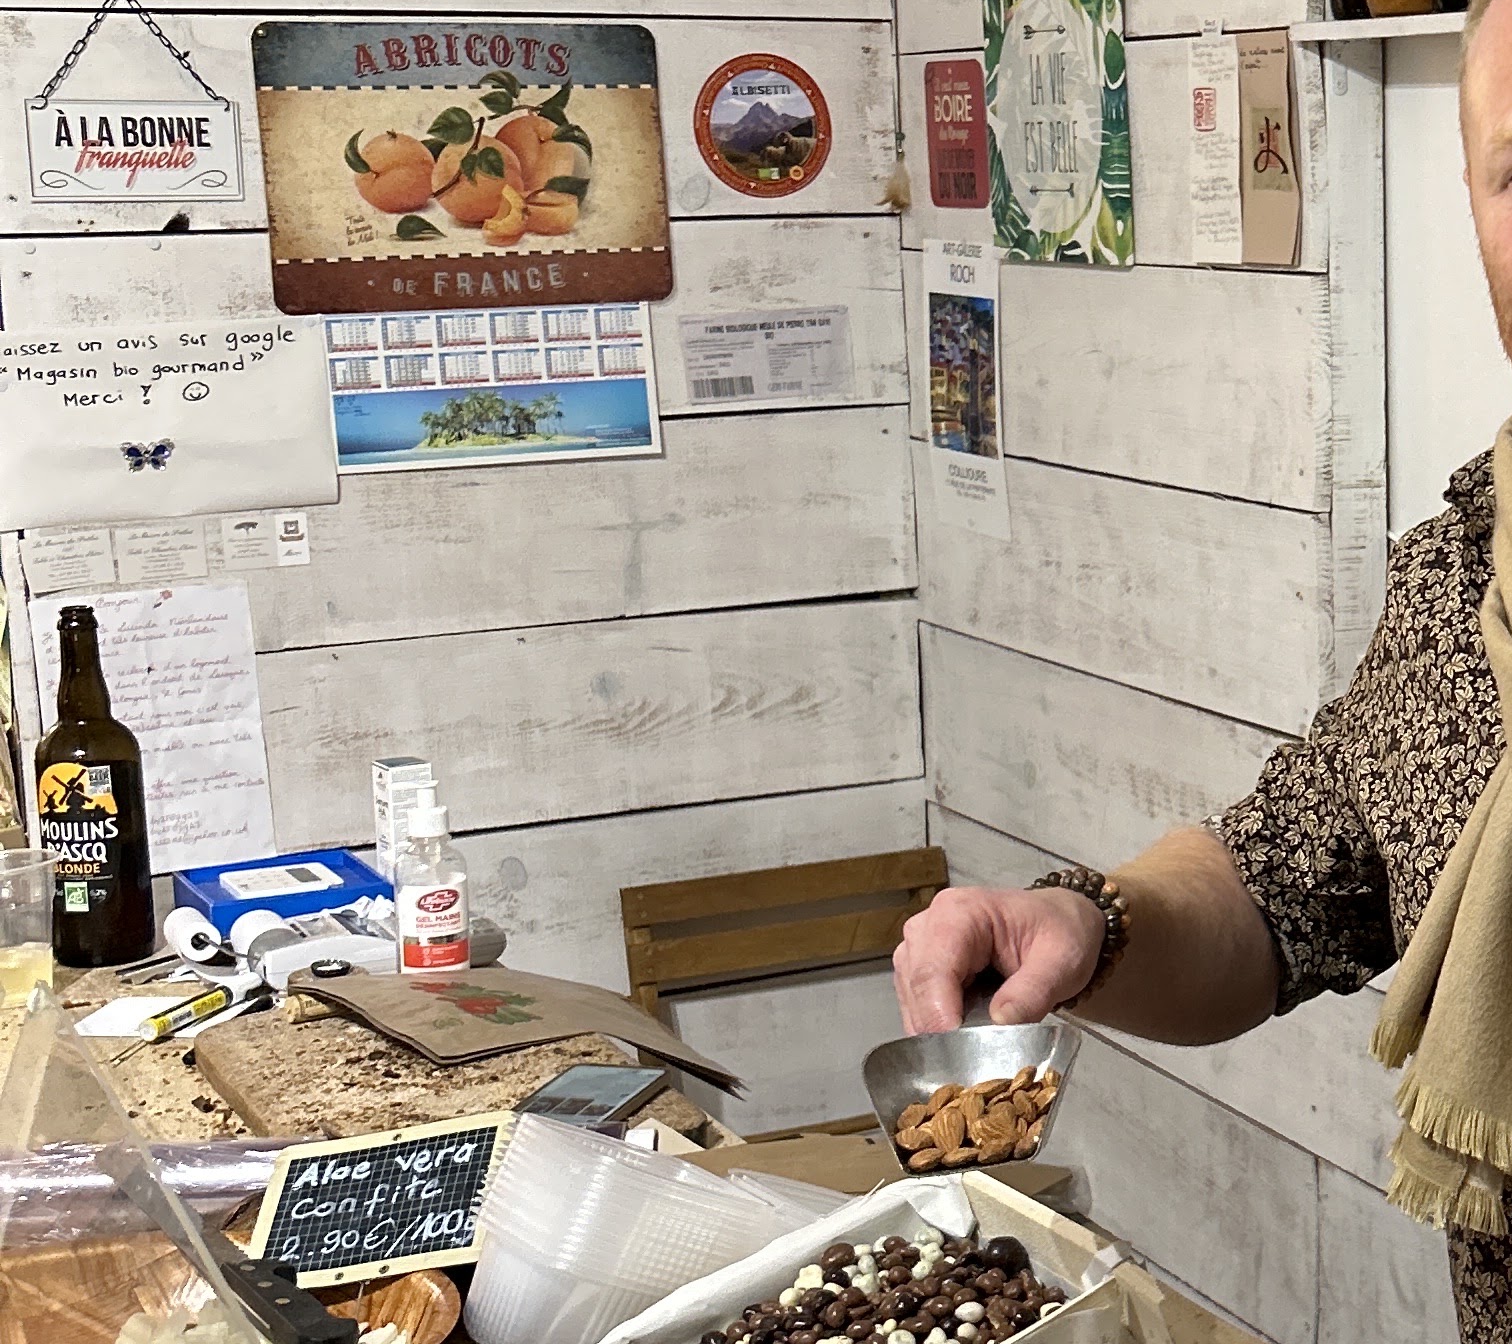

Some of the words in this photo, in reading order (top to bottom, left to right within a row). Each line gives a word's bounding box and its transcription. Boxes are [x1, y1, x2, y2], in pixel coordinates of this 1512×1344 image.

[353, 33, 571, 77] ABRICOTS
[1030, 53, 1044, 105] LA
[1049, 52, 1067, 105] VIE
[934, 94, 974, 123] BOIRE
[55, 109, 73, 147] À
[80, 115, 115, 147] LA
[121, 116, 212, 148] BONNE
[1024, 121, 1044, 173] EST
[1050, 120, 1079, 173] BELLE
[392, 277, 417, 296] DE
[433, 263, 567, 297] FRANCE
[949, 263, 975, 284] ROCH
[78, 341, 102, 352] un
[117, 335, 158, 350] avis
[179, 333, 207, 347] sur
[225, 325, 296, 352] google
[17, 366, 97, 386] Magasin
[113, 362, 139, 377] bio
[64, 392, 124, 407] Merci
[40, 816, 118, 841] MOULINS
[47, 841, 108, 863] D'ASCQ
[435, 911, 461, 922] MAINS
[292, 1159, 371, 1191] Aloe
[395, 1142, 478, 1173] vera
